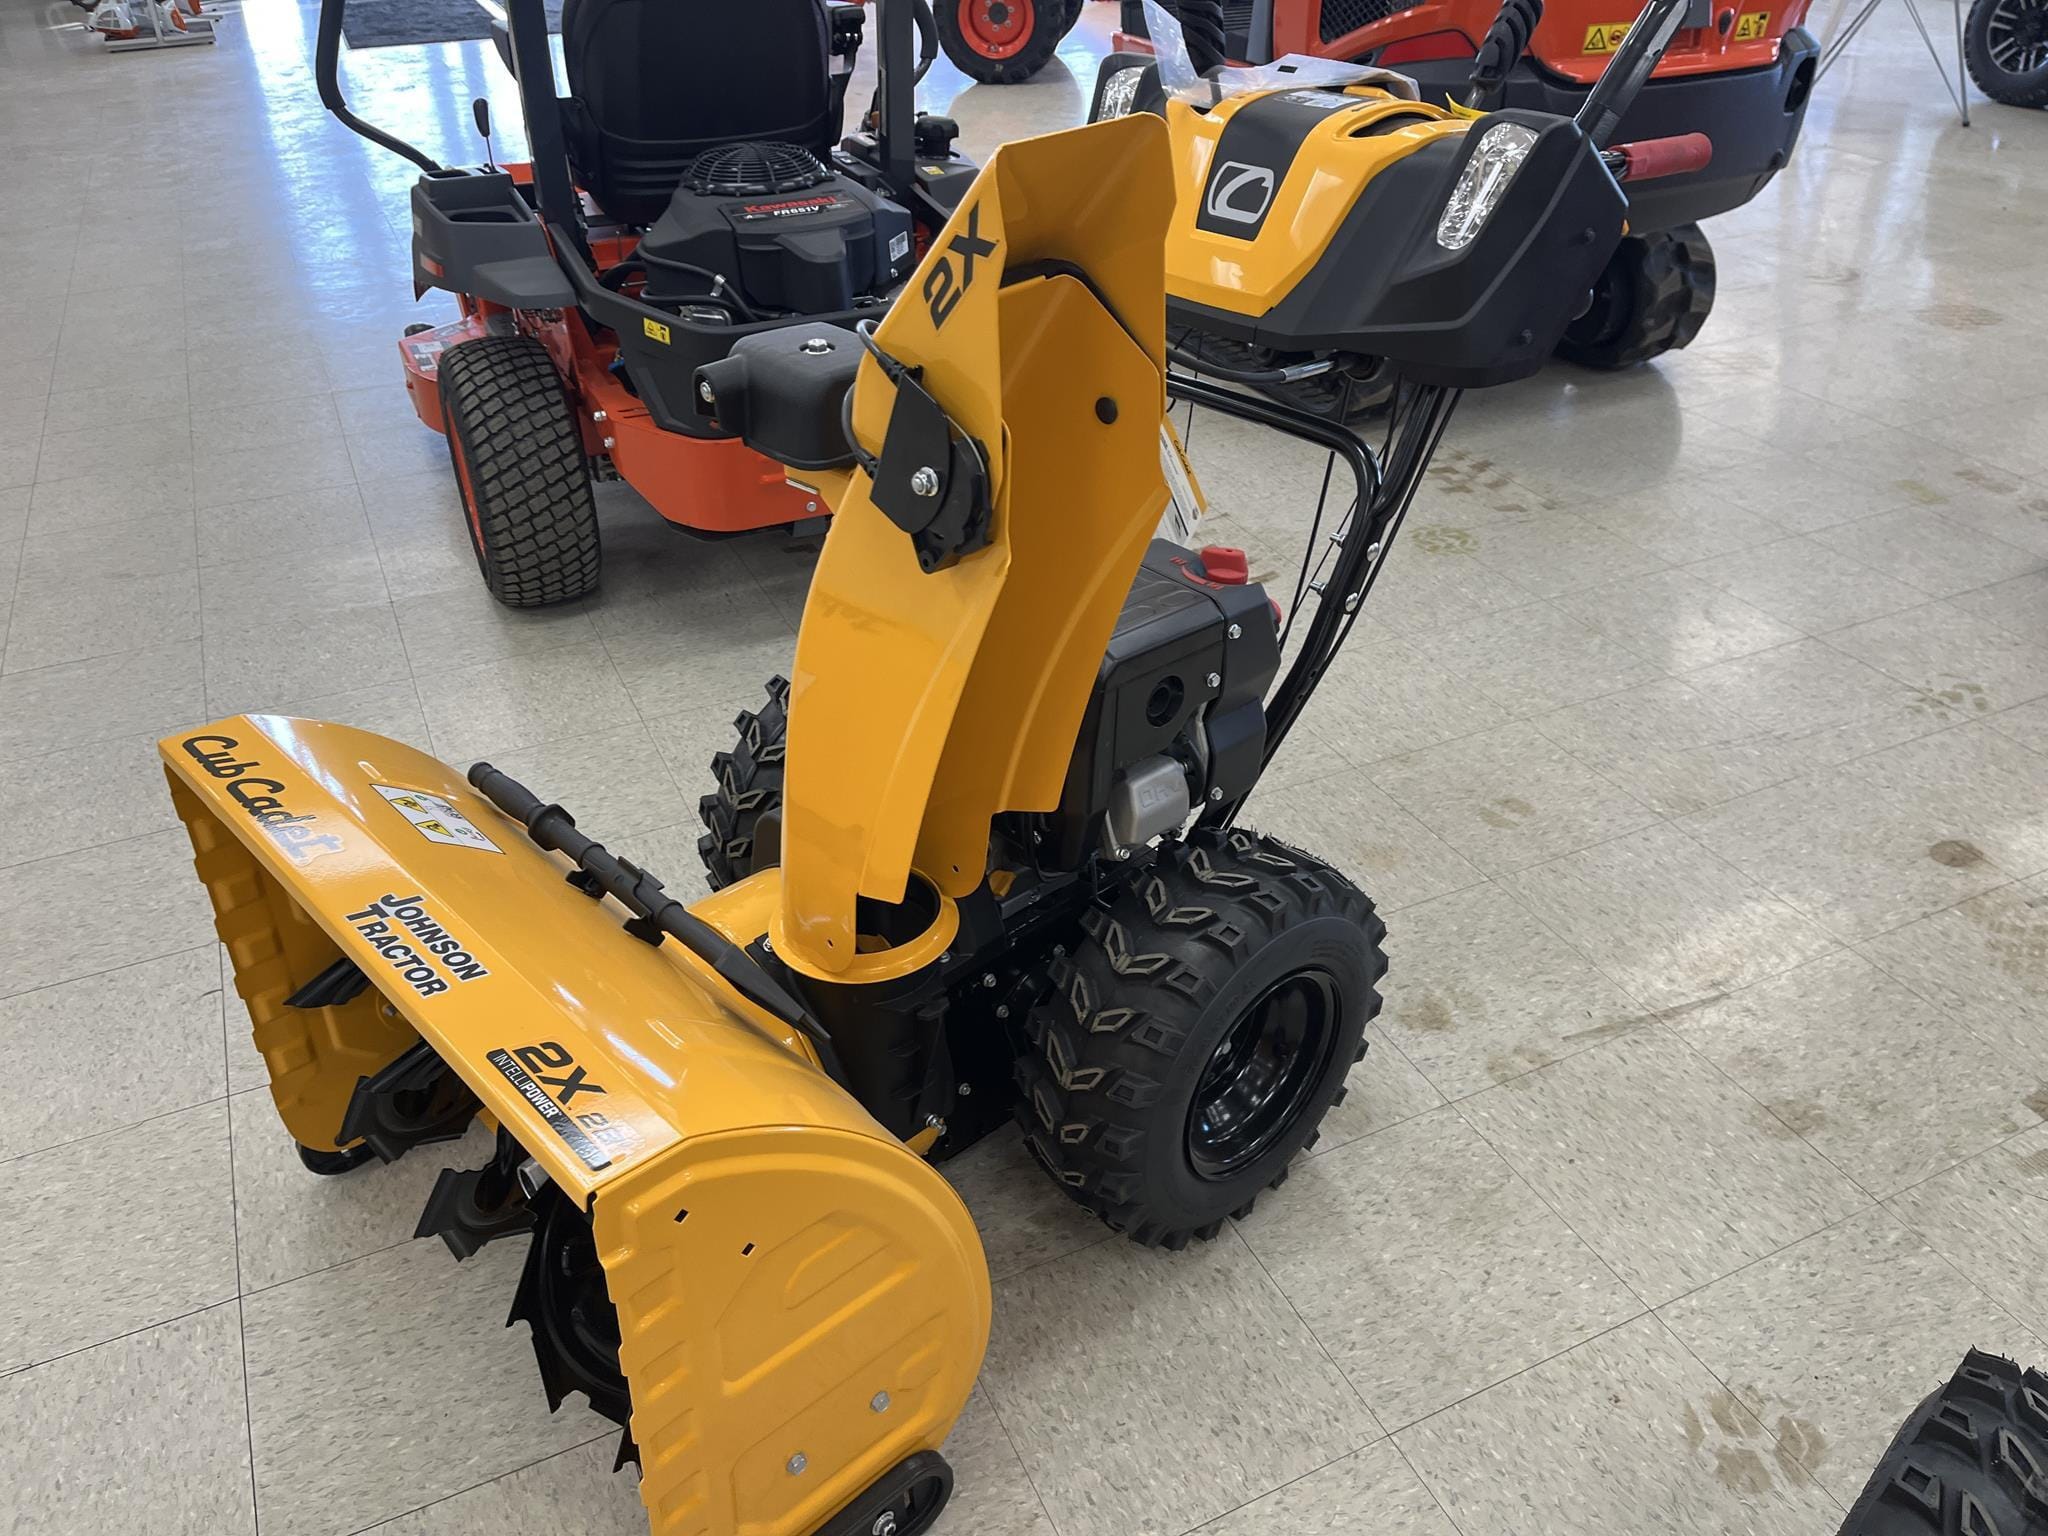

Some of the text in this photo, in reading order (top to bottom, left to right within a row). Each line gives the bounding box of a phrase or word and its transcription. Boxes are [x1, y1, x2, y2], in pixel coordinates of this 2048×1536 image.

[744, 195, 836, 213] Kawasaki
[923, 200, 997, 330] 2X
[182, 735, 343, 862] Cub Cadet
[345, 903, 448, 997] TRACTOR
[380, 893, 489, 981] JOHNSON
[512, 1041, 608, 1106] 2X
